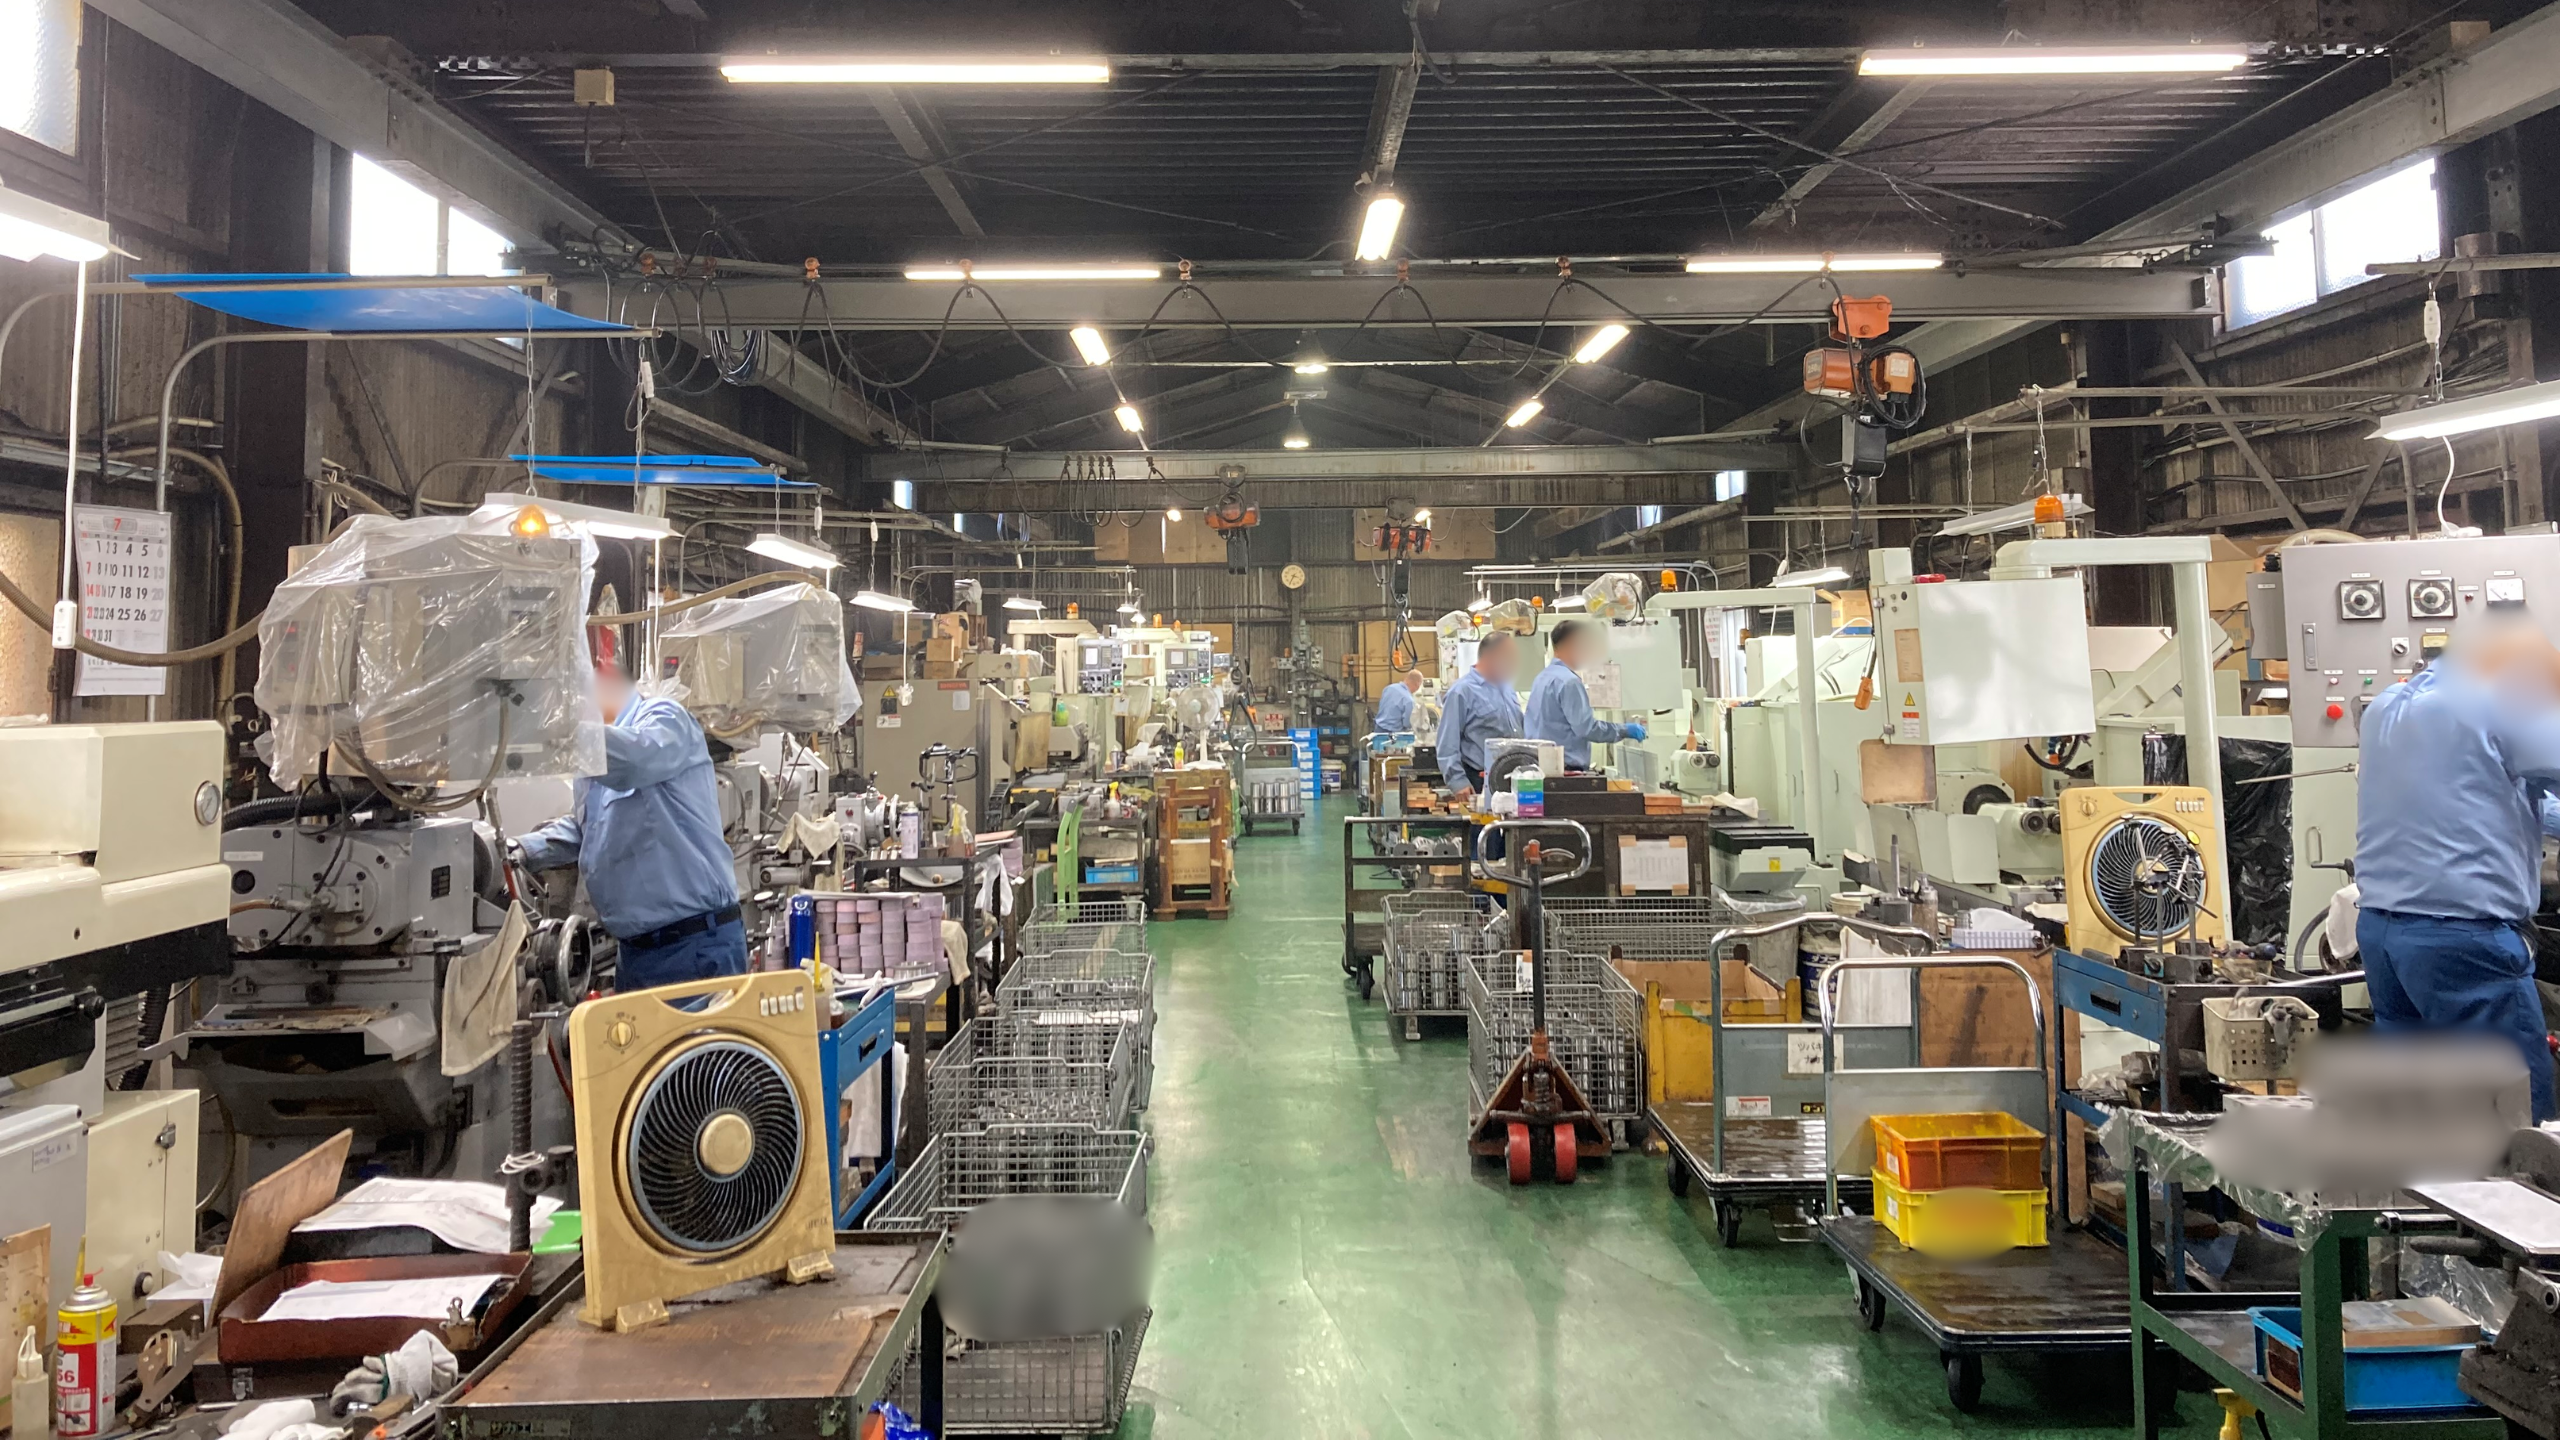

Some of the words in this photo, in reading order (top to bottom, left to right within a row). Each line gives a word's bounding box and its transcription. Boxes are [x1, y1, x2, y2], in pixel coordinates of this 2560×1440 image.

[113, 517, 122, 531] 7
[97, 540, 101, 553] 1
[106, 541, 110, 554] 2
[112, 542, 118, 555] 3
[126, 543, 133, 556] 4
[141, 544, 149, 557] 5
[157, 545, 164, 558] 6
[86, 561, 92, 575] 7
[98, 562, 102, 575] 8
[109, 564, 118, 576] 10
[122, 565, 133, 578] 11
[138, 566, 149, 578] 12
[153, 566, 165, 579] 13
[86, 584, 94, 597] 14
[107, 586, 116, 598] 17
[120, 587, 132, 599] 18
[137, 587, 148, 600] 19
[151, 588, 164, 601] 20
[105, 608, 114, 620] 24
[118, 608, 131, 621] 25
[134, 609, 147, 621] 26
[149, 609, 163, 622] 27
[104, 629, 112, 642] 31
